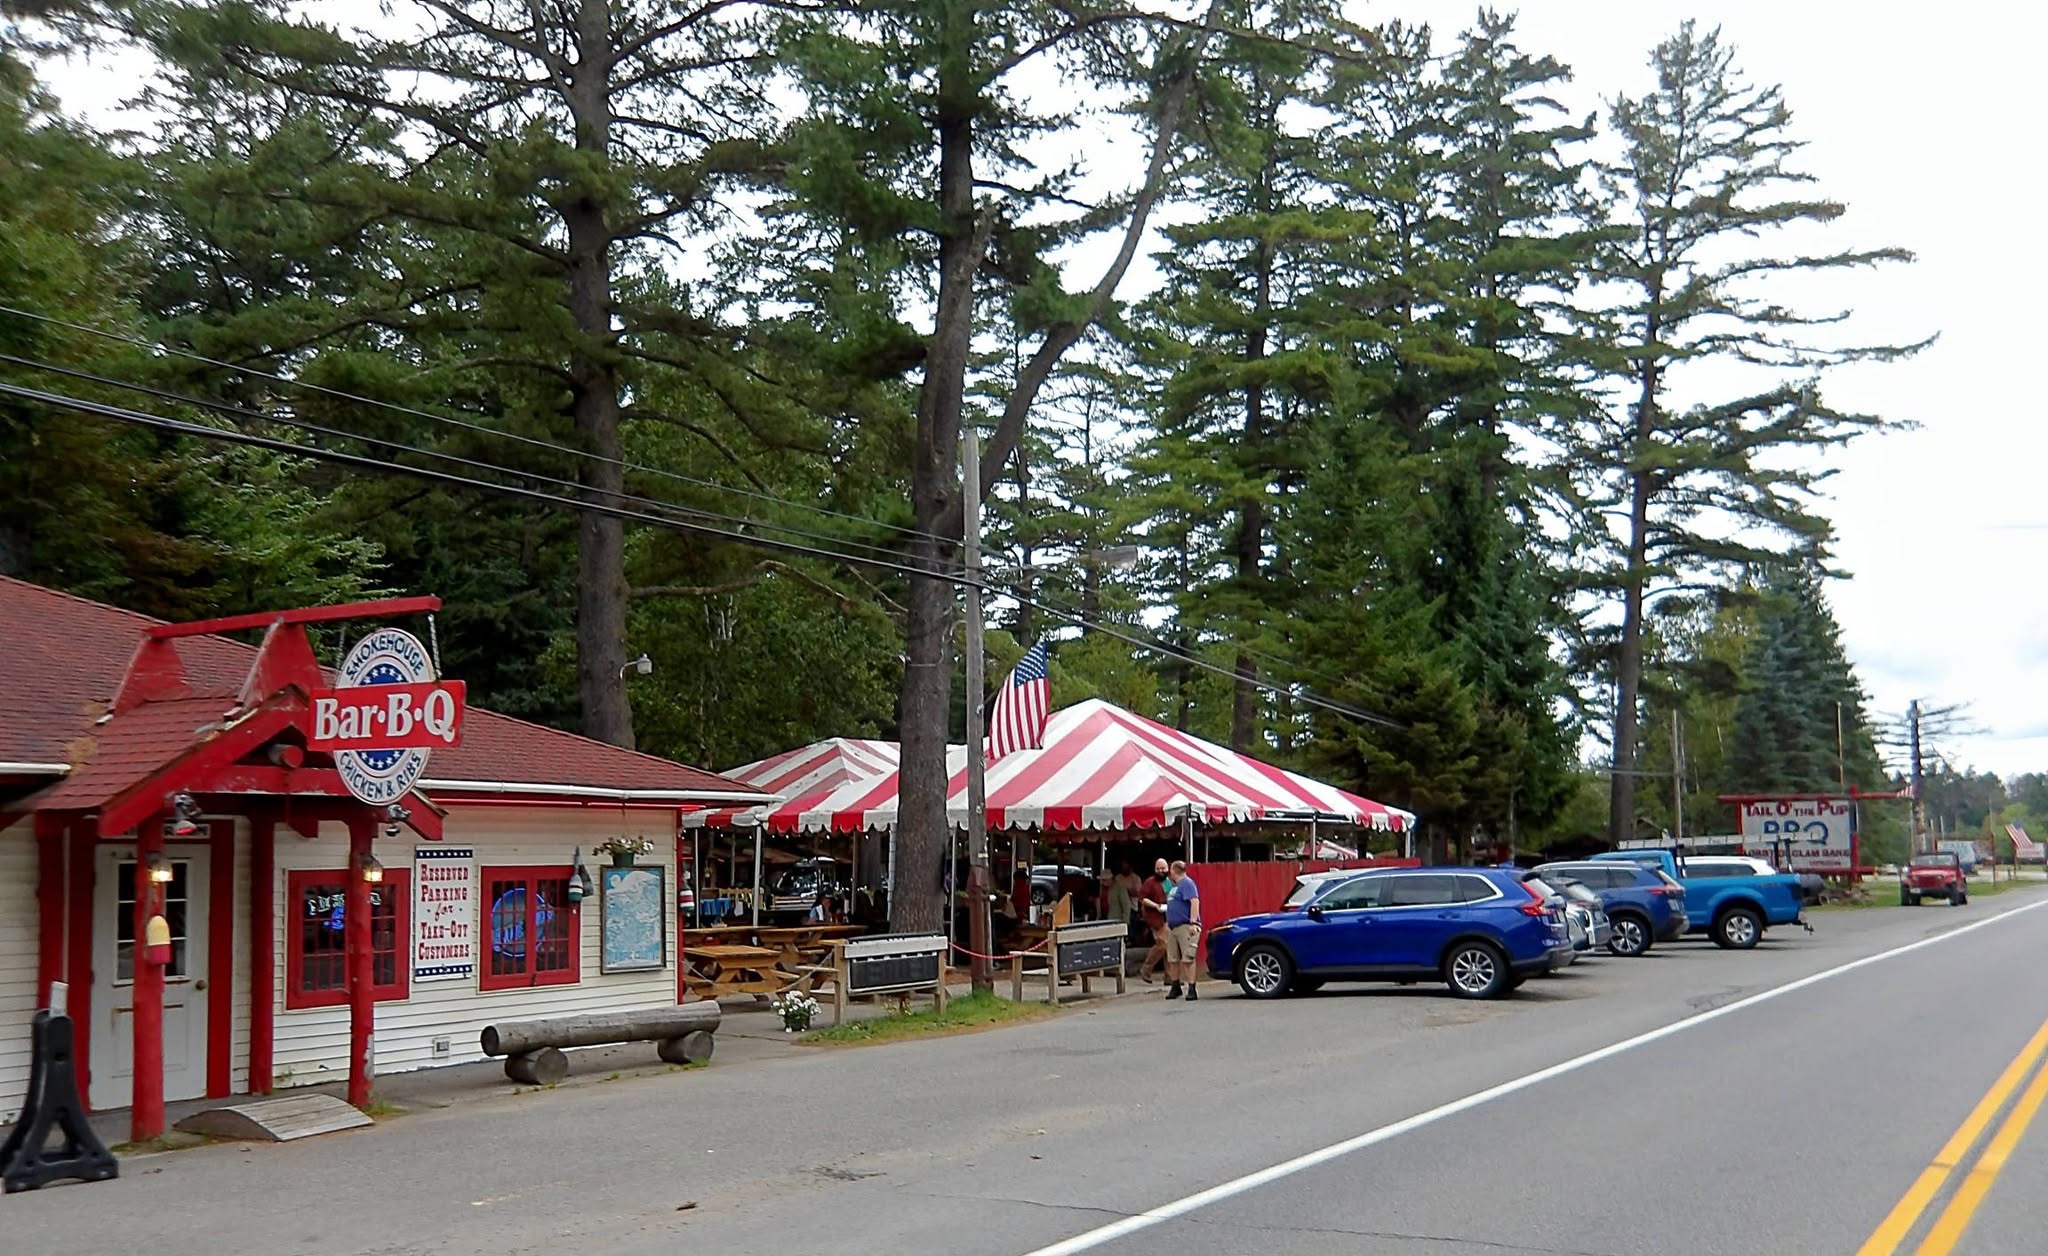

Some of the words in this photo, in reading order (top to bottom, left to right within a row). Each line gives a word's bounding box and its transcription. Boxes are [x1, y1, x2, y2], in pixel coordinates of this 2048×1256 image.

[346, 633, 425, 681] SMOKEHOUSE
[339, 752, 384, 799] CHICKEN
[386, 780, 396, 797] &
[397, 753, 422, 788] RIBS
[1745, 801, 1773, 816] TAIL
[1795, 807, 1815, 817] THE
[1817, 799, 1849, 816] PUP
[1792, 848, 1820, 858] CLAM
[421, 864, 469, 881] RESERVED
[421, 885, 467, 902] PARKING
[434, 902, 454, 921] for
[421, 920, 468, 939] TAKE-OUT
[418, 942, 469, 960] CUSTOMERS
